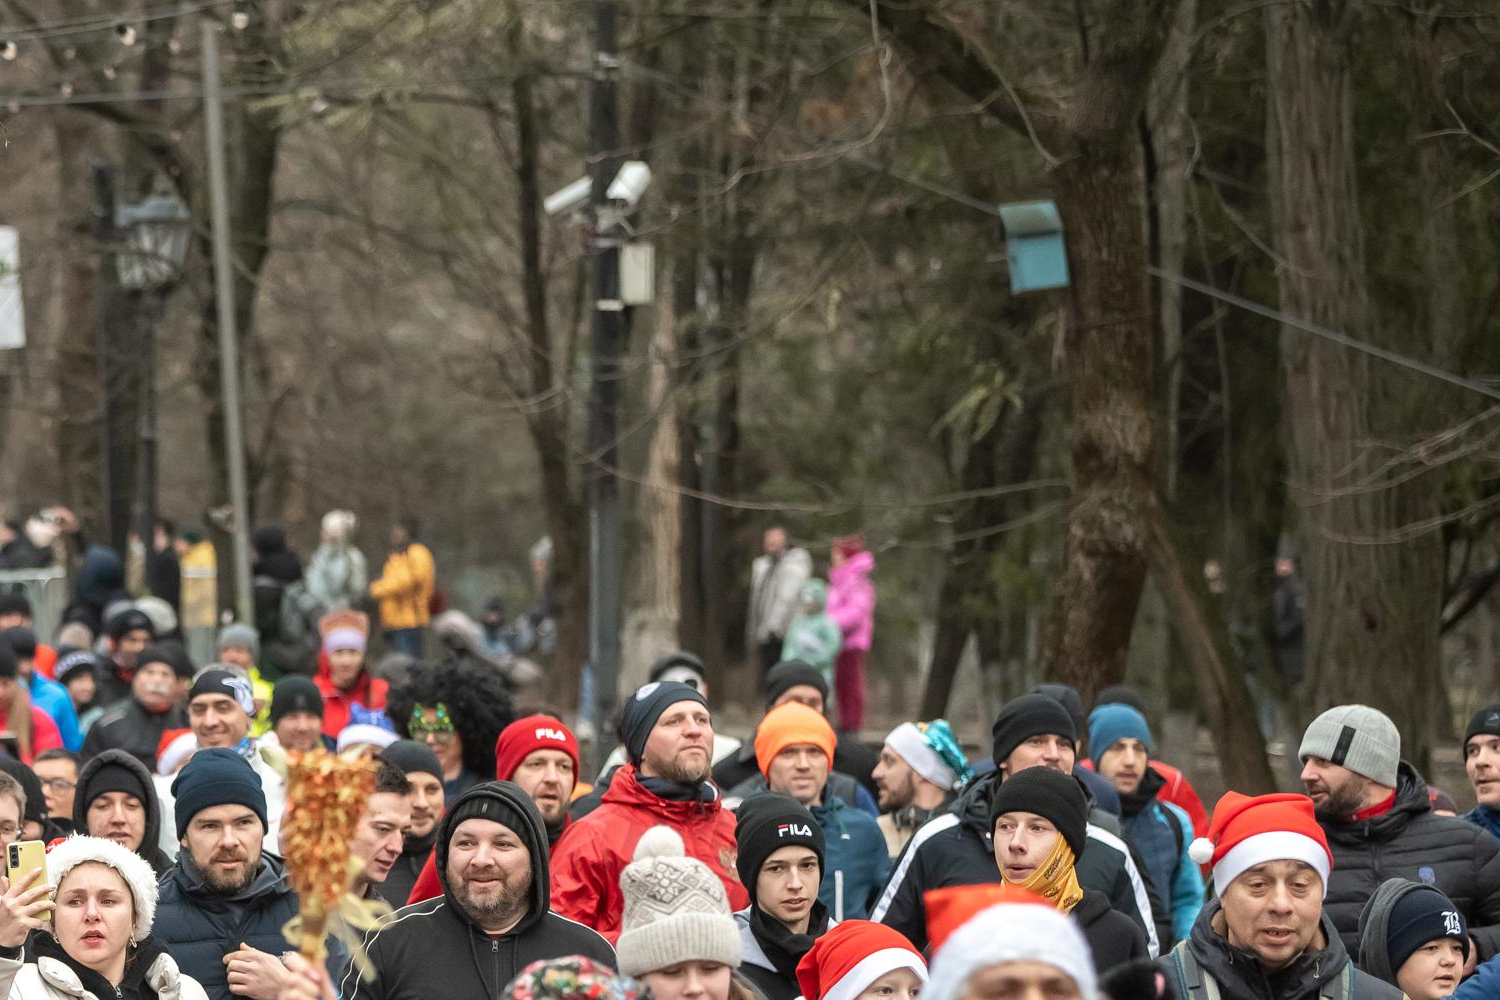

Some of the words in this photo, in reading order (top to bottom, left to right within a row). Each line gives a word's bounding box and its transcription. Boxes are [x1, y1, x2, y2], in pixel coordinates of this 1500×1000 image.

[535, 728, 566, 742] FILA
[777, 823, 813, 838] FILA
[1441, 911, 1462, 935] B
